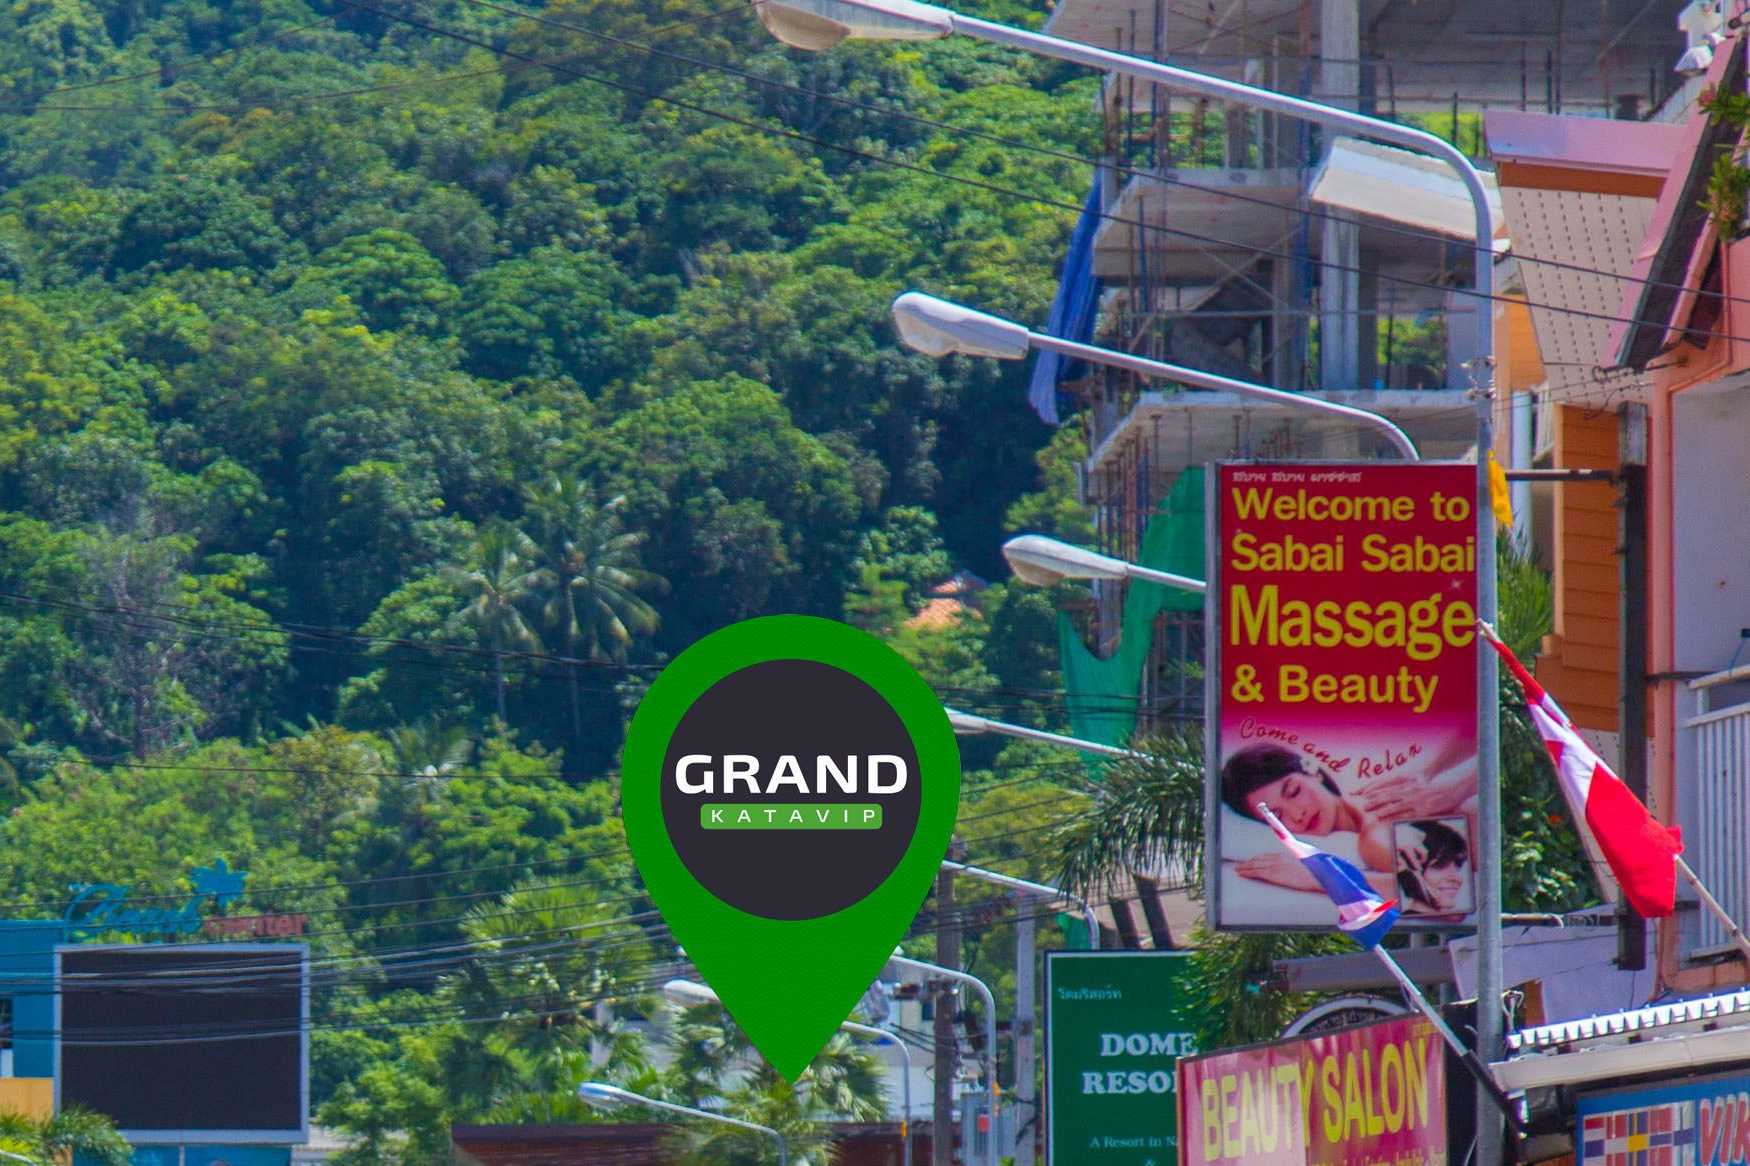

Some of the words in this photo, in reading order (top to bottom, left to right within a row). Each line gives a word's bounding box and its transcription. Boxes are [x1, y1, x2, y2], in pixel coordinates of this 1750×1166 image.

[1231, 487, 1415, 521] Welcome
[1430, 492, 1470, 521] to
[1231, 533, 1344, 572] Sabai
[1361, 533, 1475, 572] Sabai
[1230, 583, 1476, 661] Massage
[1231, 663, 1264, 703] &
[1279, 664, 1440, 713] Beauty
[1240, 717, 1299, 745] Come
[1302, 742, 1352, 773] and
[1357, 742, 1423, 779] Relax
[1100, 1033, 1199, 1057] DOME
[1200, 1060, 1314, 1163] BEAUTY
[1320, 1037, 1429, 1145] SALON
[1090, 1137, 1100, 1148] A
[1104, 1137, 1144, 1148] Resort
